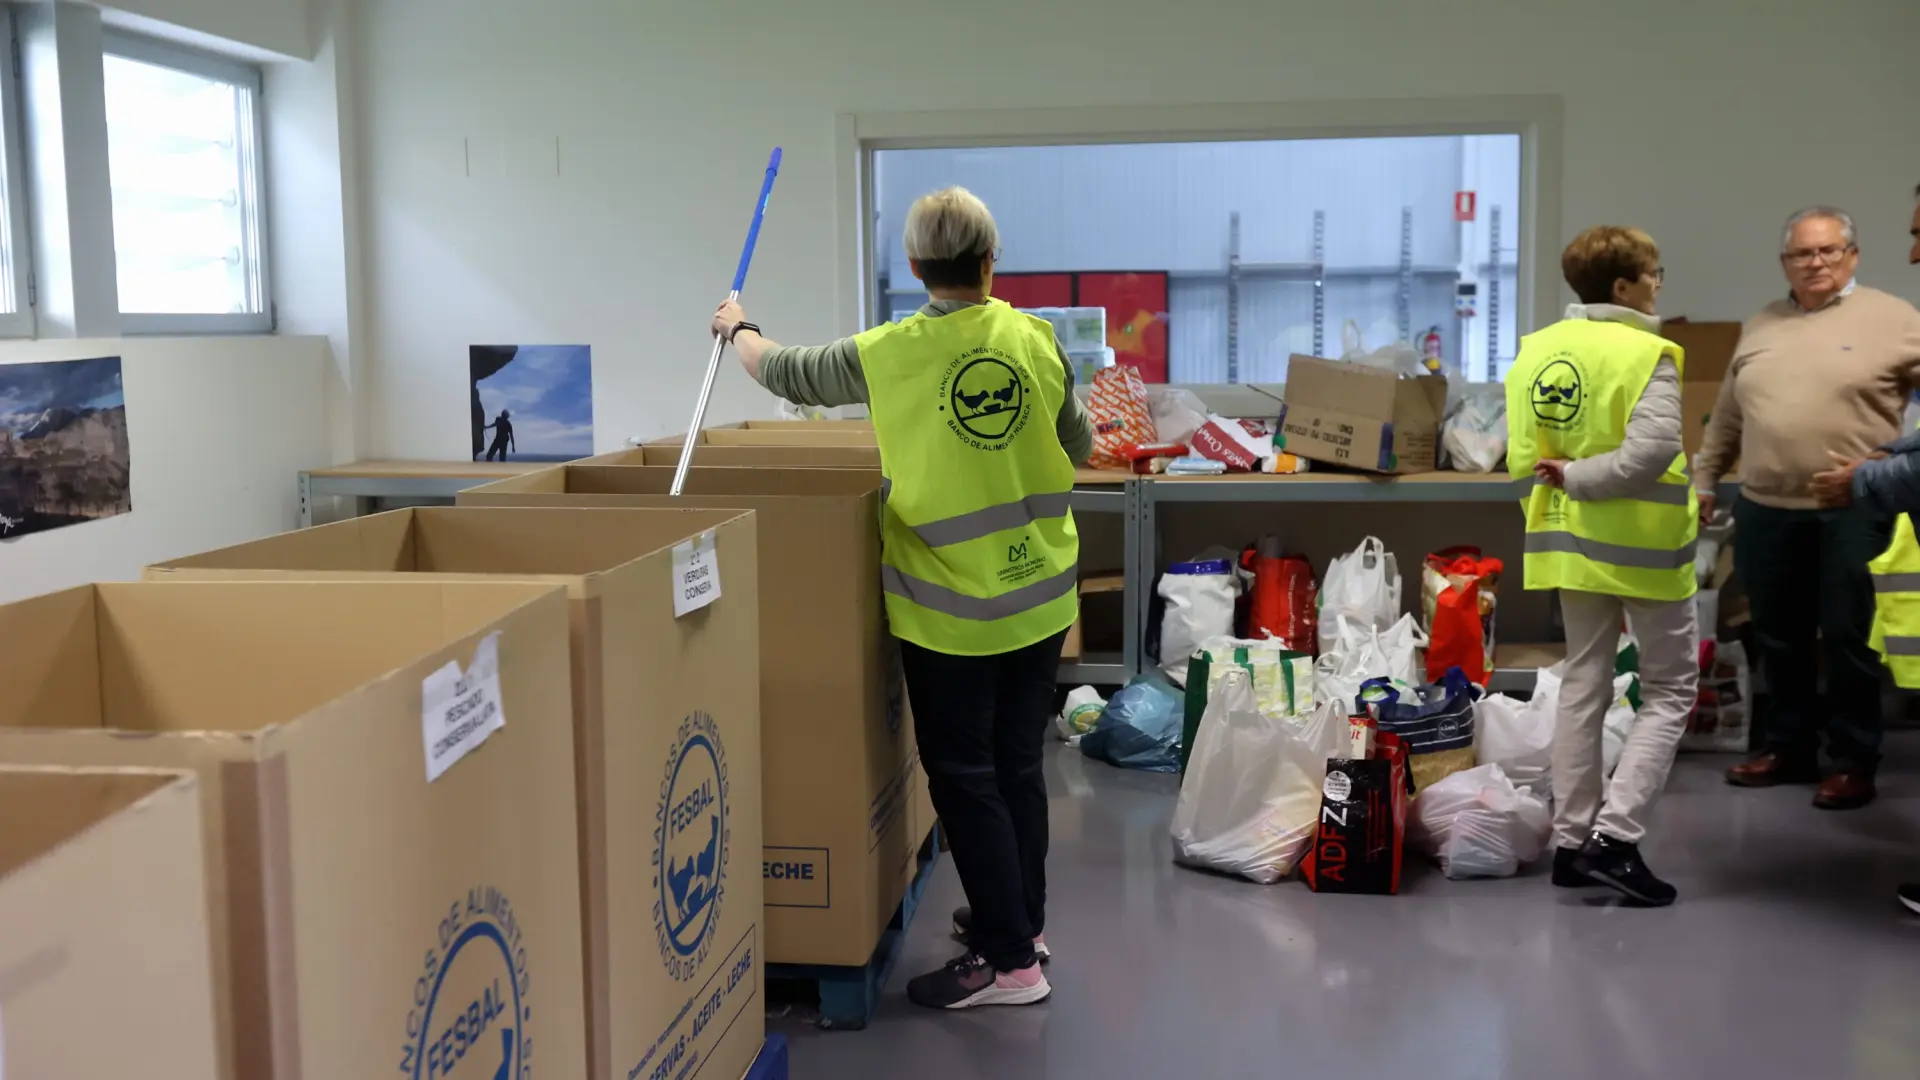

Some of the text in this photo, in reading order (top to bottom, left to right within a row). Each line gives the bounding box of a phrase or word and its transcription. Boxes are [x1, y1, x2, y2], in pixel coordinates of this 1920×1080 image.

[940, 347, 1029, 398] BANCO DE ALIMENTOS HUESCA
[947, 419, 969, 443] BANCO
[970, 440, 980, 449] DE
[1013, 403, 1031, 436] HUESCA
[652, 709, 729, 867] BANCOS DE ALIMENTOS
[669, 777, 714, 841] FESBAL
[438, 901, 461, 952] DE
[464, 884, 530, 998] ALIMENTOS
[683, 957, 695, 982] DE
[427, 977, 505, 1080] FESBAL
[692, 987, 722, 1042] ACEITE
[727, 948, 752, 995] LECHE
